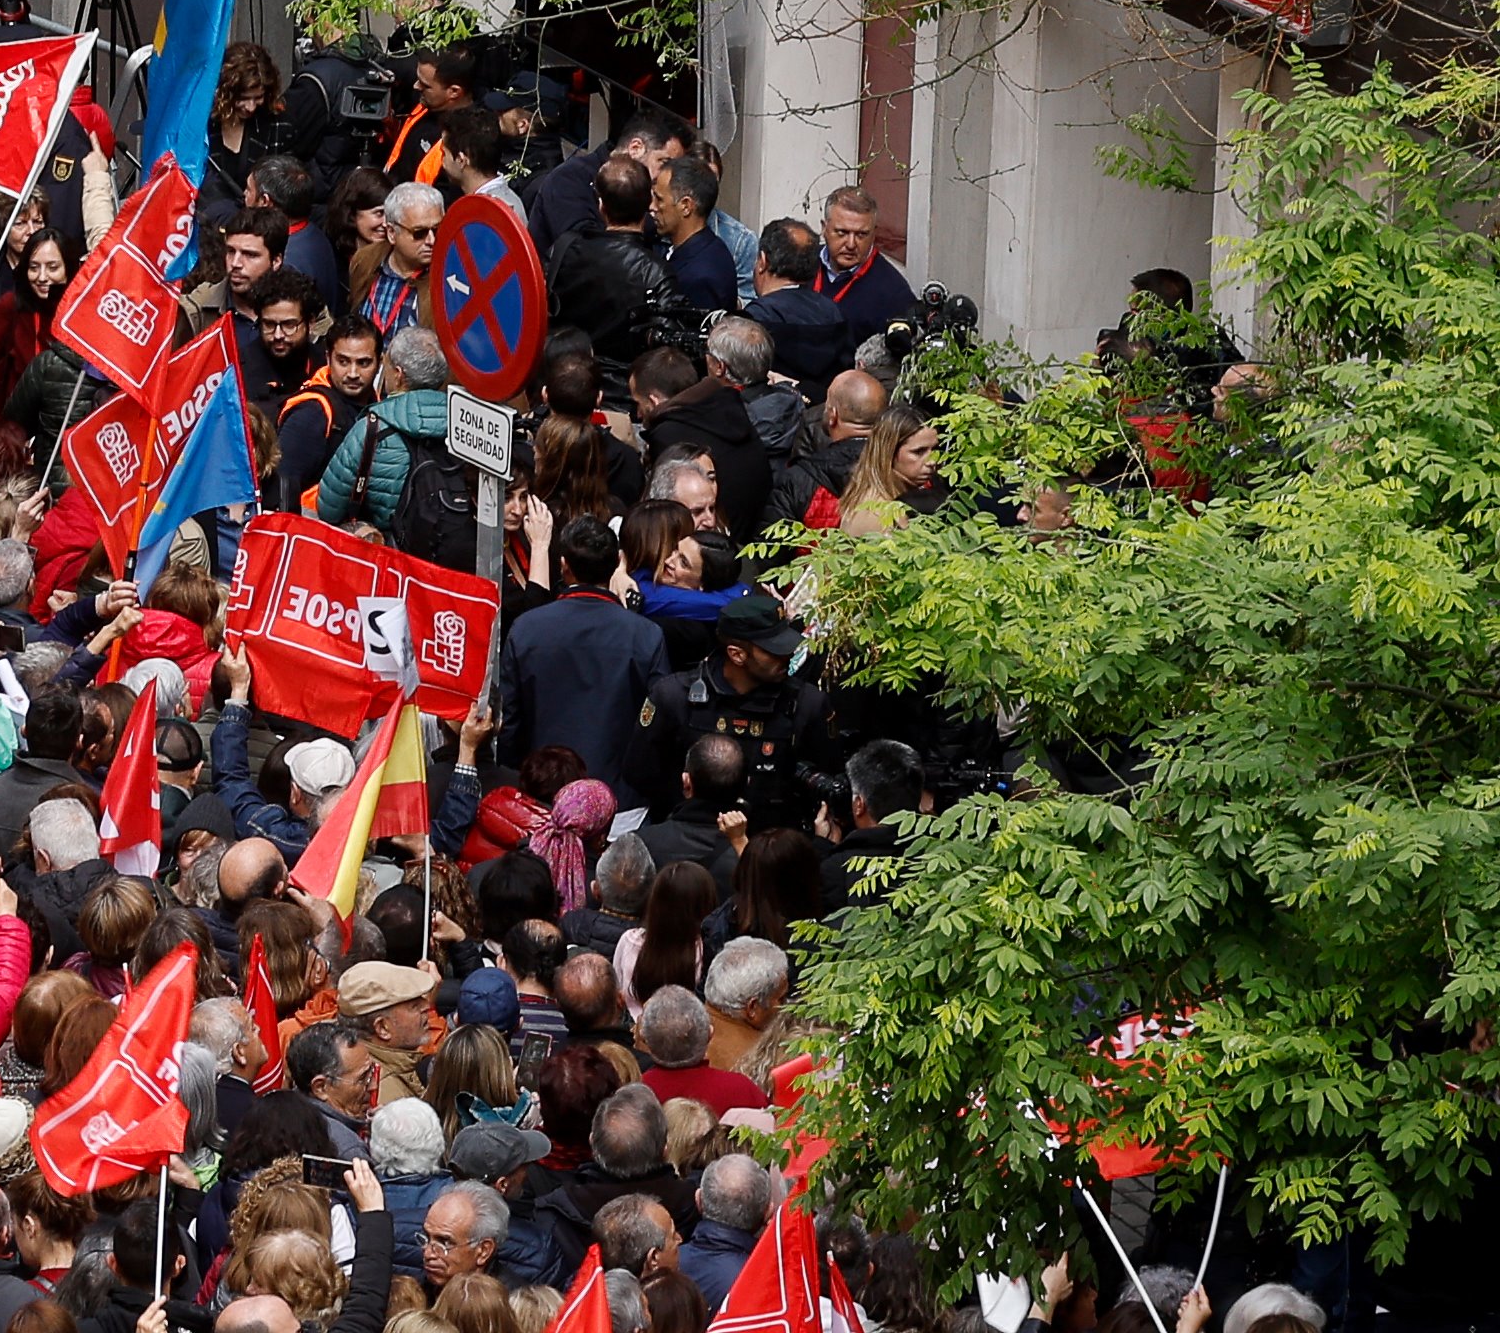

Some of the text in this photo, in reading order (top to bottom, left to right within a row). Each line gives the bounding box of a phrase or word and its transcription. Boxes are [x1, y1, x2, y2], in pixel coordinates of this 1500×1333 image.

[458, 406, 501, 438] ZONA DE
[453, 424, 505, 463] SEGURIDAD
